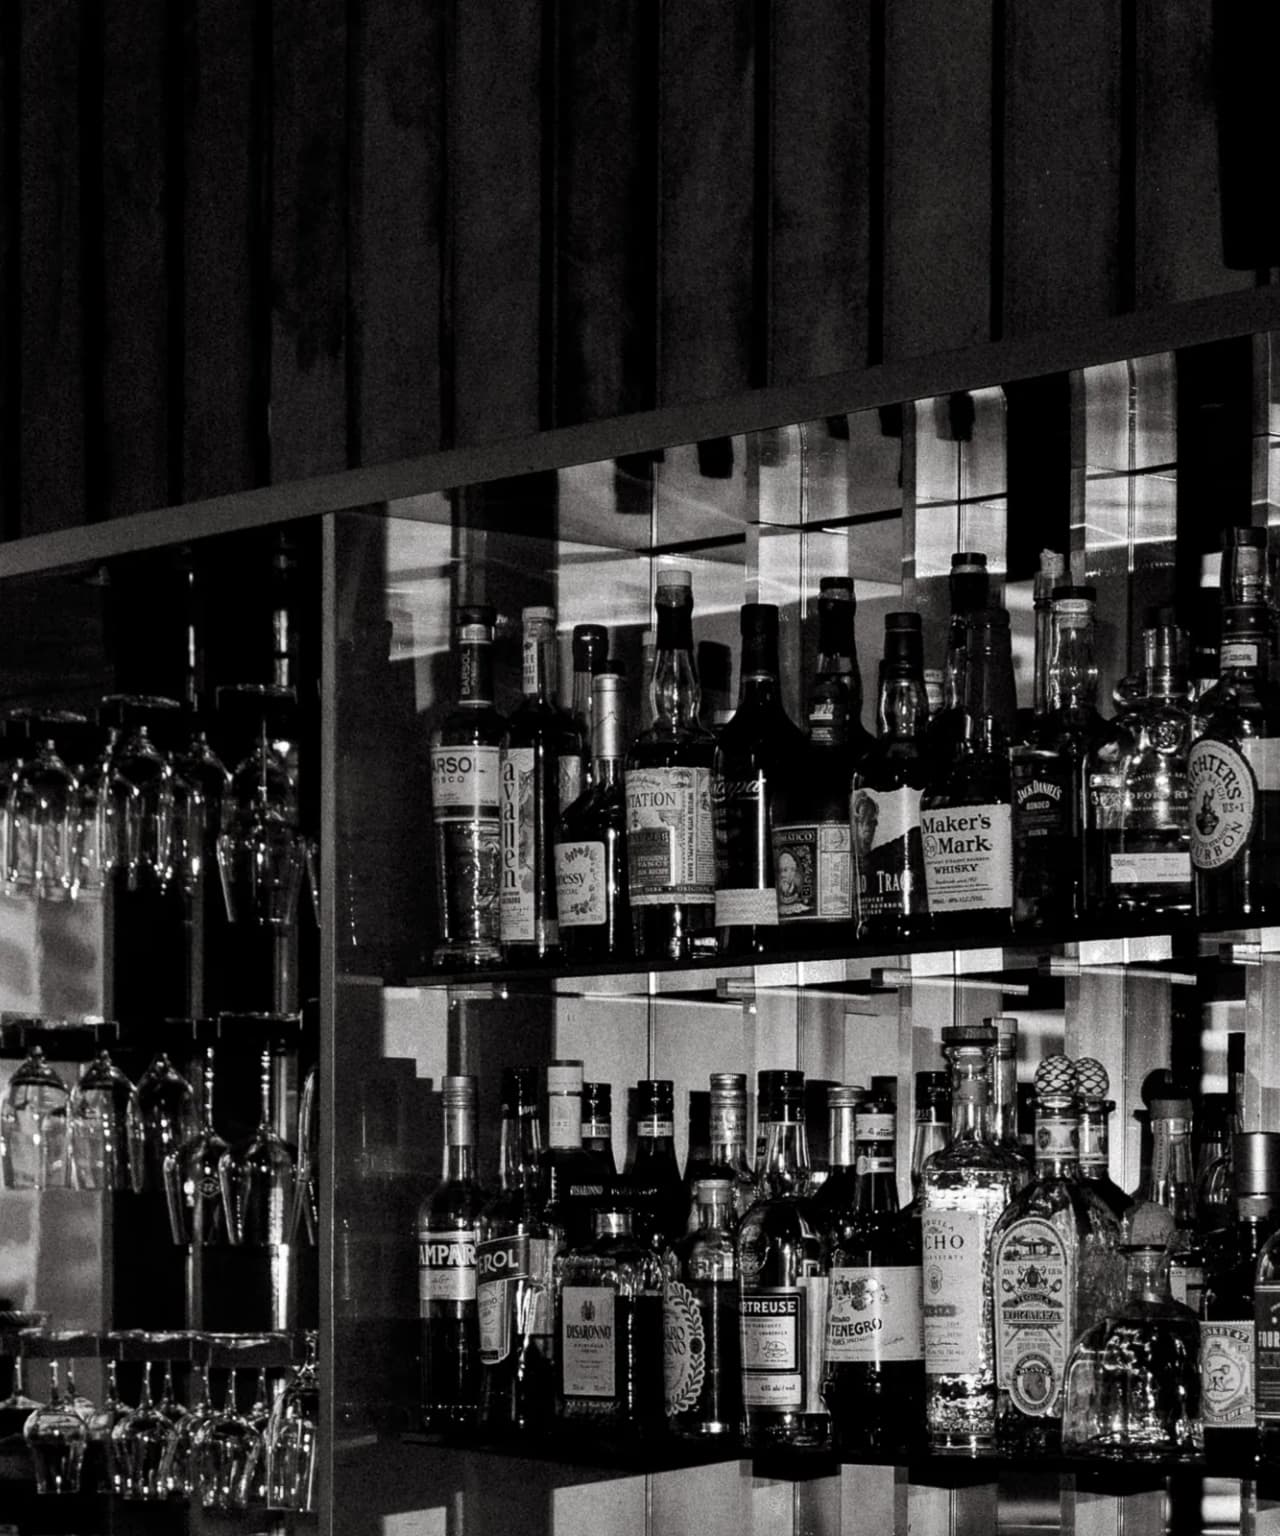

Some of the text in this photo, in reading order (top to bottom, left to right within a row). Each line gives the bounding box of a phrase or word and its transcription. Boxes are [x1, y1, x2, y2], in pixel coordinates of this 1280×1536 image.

[433, 755, 486, 774] ARSOL
[434, 775, 465, 784] ISCO
[1190, 753, 1242, 801] ICHTER'S
[630, 791, 677, 808] TATION
[1033, 779, 1063, 801] DANIEL'S
[921, 813, 992, 834] Maker's
[938, 835, 993, 855] Mark
[1194, 820, 1243, 863] URBON
[934, 863, 979, 875] WHISKY
[925, 1234, 965, 1250] CHO
[420, 1243, 477, 1267] AMPAR
[479, 1249, 520, 1274] EROL
[742, 1300, 797, 1314] RTREUSE
[831, 1318, 883, 1338] TENEGRO
[1258, 1330, 1280, 1348] FOUR
